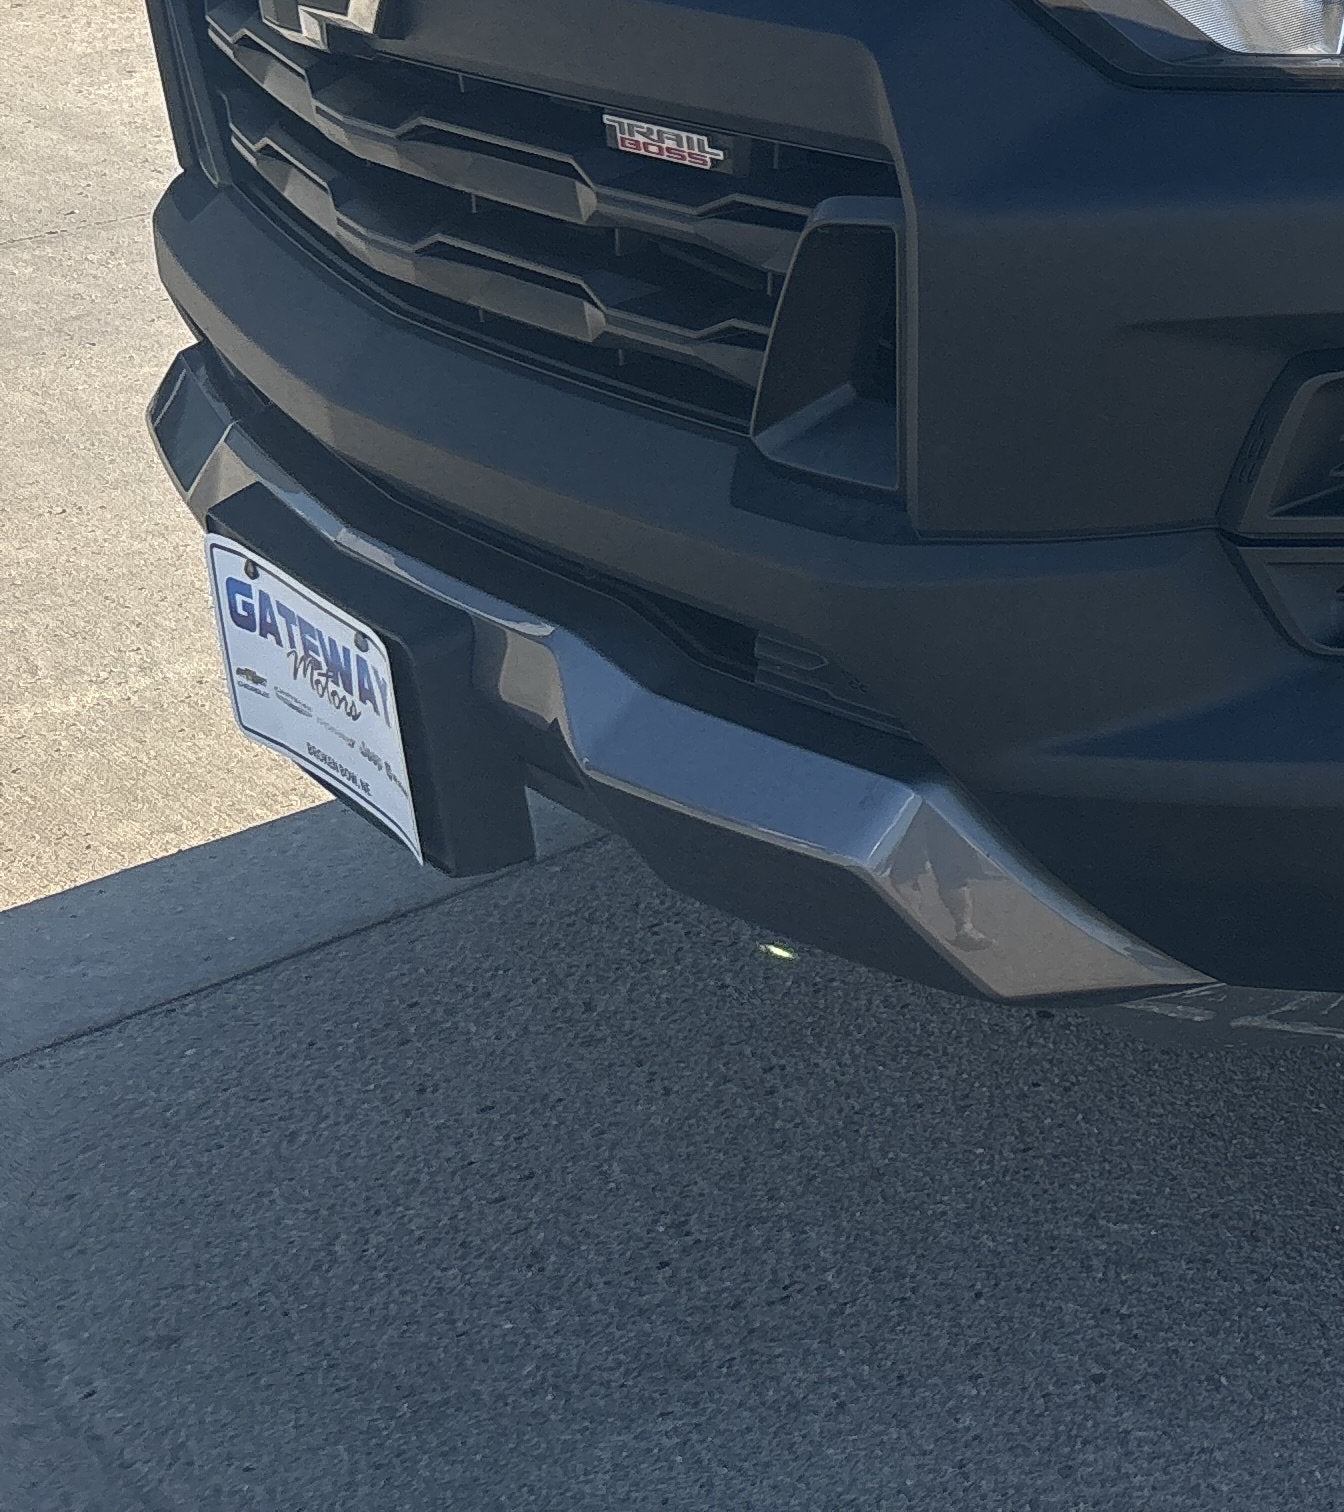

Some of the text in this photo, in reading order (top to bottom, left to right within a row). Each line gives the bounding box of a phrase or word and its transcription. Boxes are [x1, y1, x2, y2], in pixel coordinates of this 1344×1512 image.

[602, 113, 725, 161] TRAIL
[618, 135, 712, 170] BOSS
[226, 575, 392, 730] GATEWAY
[286, 648, 362, 722] Motors
